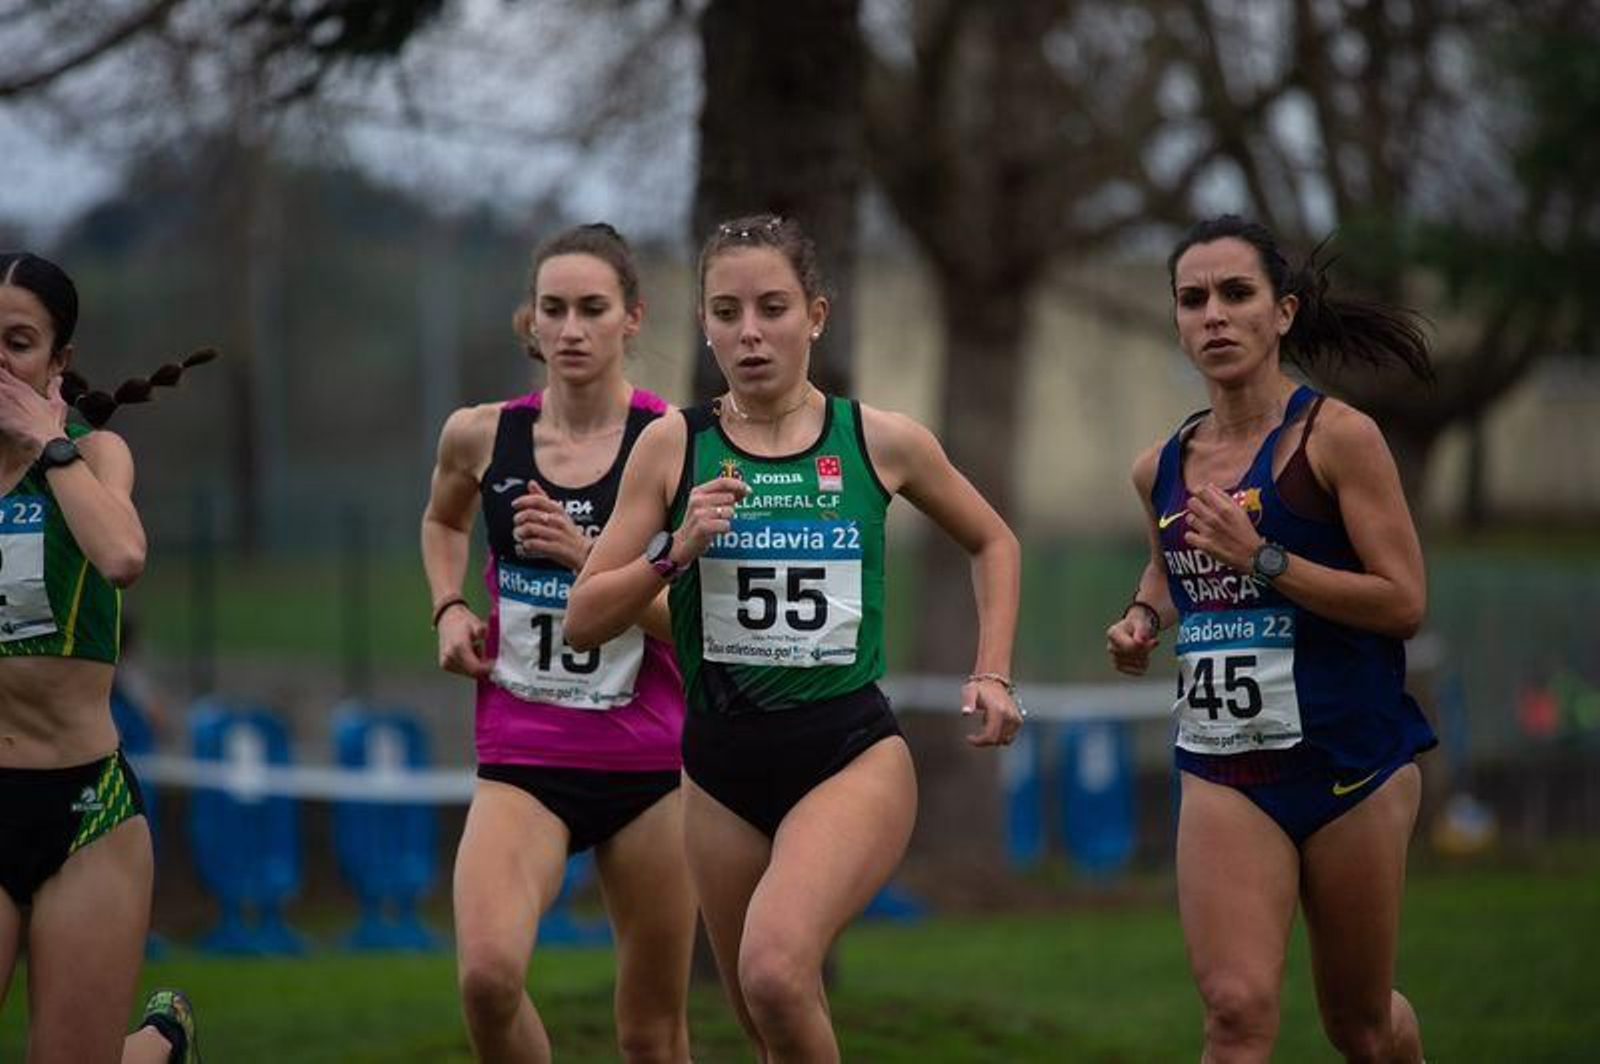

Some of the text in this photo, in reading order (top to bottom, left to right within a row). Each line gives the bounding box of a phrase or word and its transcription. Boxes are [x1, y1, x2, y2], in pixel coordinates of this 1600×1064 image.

[13, 503, 42, 524] 22
[710, 527, 860, 549] ibadavia 22
[500, 569, 569, 599] Ribada
[1182, 575, 1260, 603] BARÇA
[737, 567, 828, 631] 55
[1262, 616, 1292, 638] 22
[1188, 655, 1262, 720] 45
